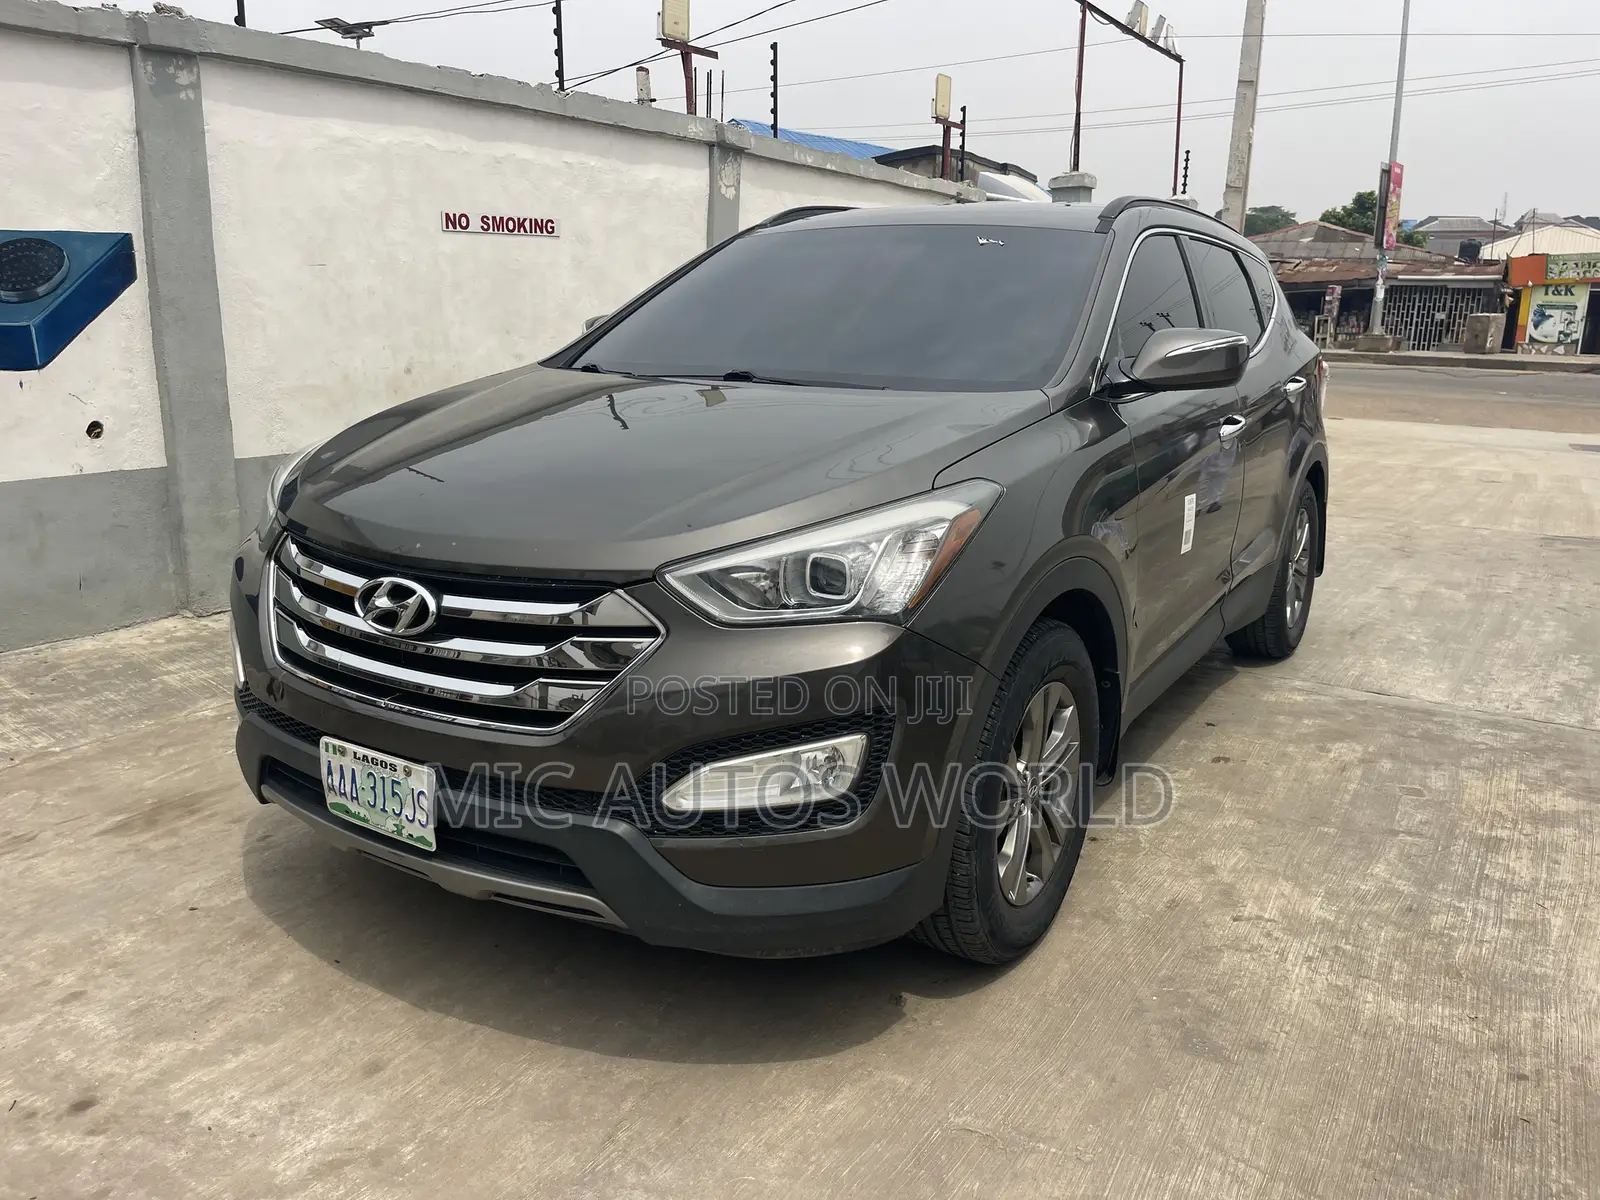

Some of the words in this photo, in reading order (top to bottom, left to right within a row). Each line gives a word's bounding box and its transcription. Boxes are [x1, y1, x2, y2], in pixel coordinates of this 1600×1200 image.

[445, 212, 470, 230] NO
[480, 215, 555, 234] SMOKING
[1544, 284, 1576, 297] T&K
[353, 751, 398, 773] LAGOS
